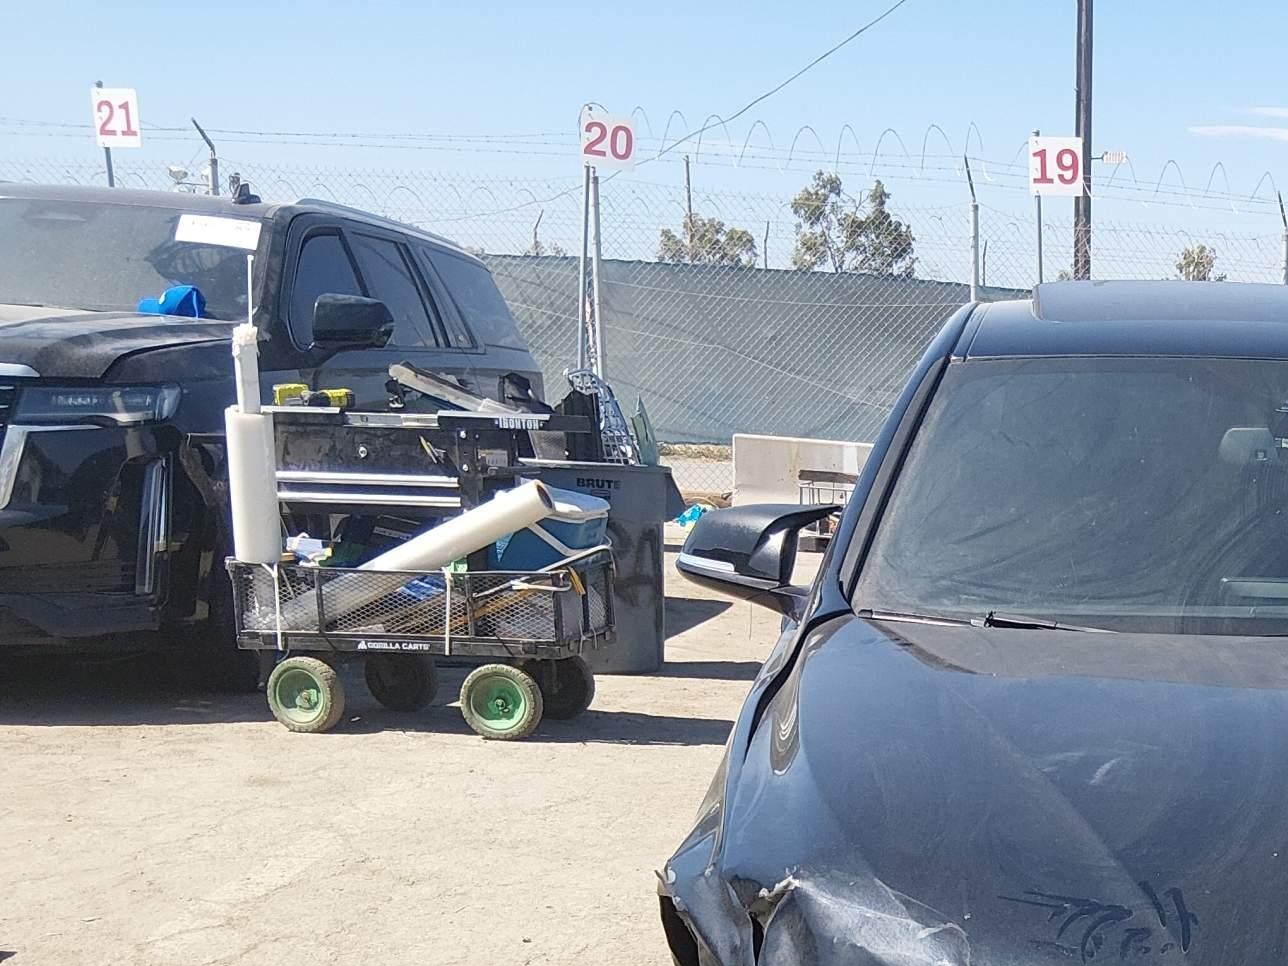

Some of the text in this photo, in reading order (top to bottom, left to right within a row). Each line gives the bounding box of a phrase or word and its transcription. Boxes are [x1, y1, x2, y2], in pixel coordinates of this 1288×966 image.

[96, 100, 138, 136] 21
[584, 121, 633, 161] 20
[1032, 148, 1079, 185] 19
[576, 478, 620, 490] BRUTE
[401, 642, 430, 651] CARTS
